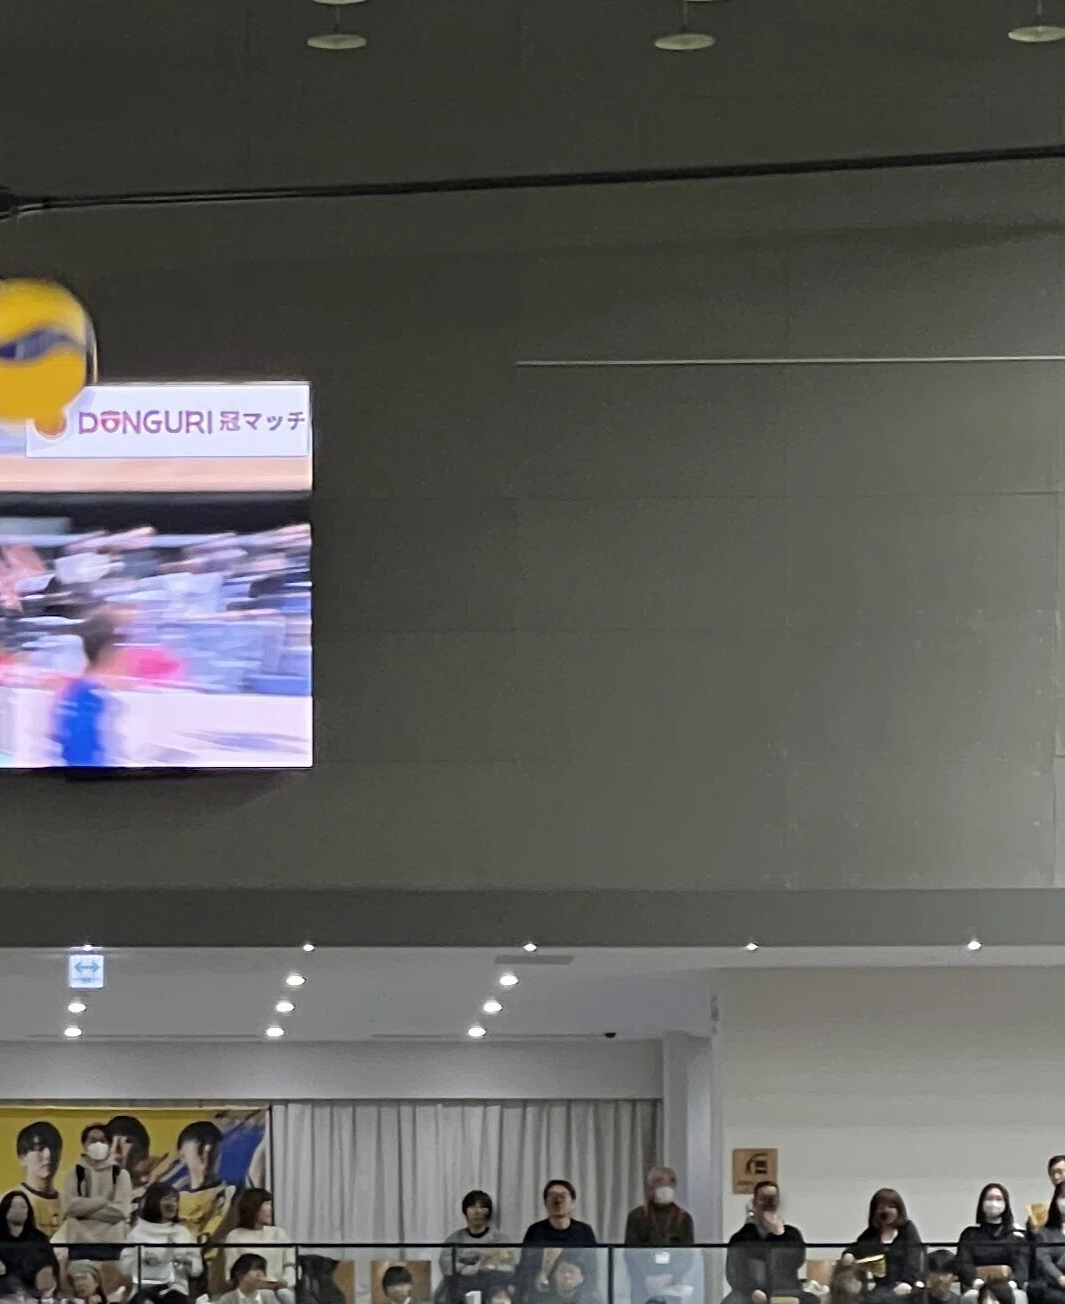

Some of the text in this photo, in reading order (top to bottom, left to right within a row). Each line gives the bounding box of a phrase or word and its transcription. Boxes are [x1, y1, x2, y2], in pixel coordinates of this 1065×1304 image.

[78, 410, 306, 435] DONGURI 冠マッチ
